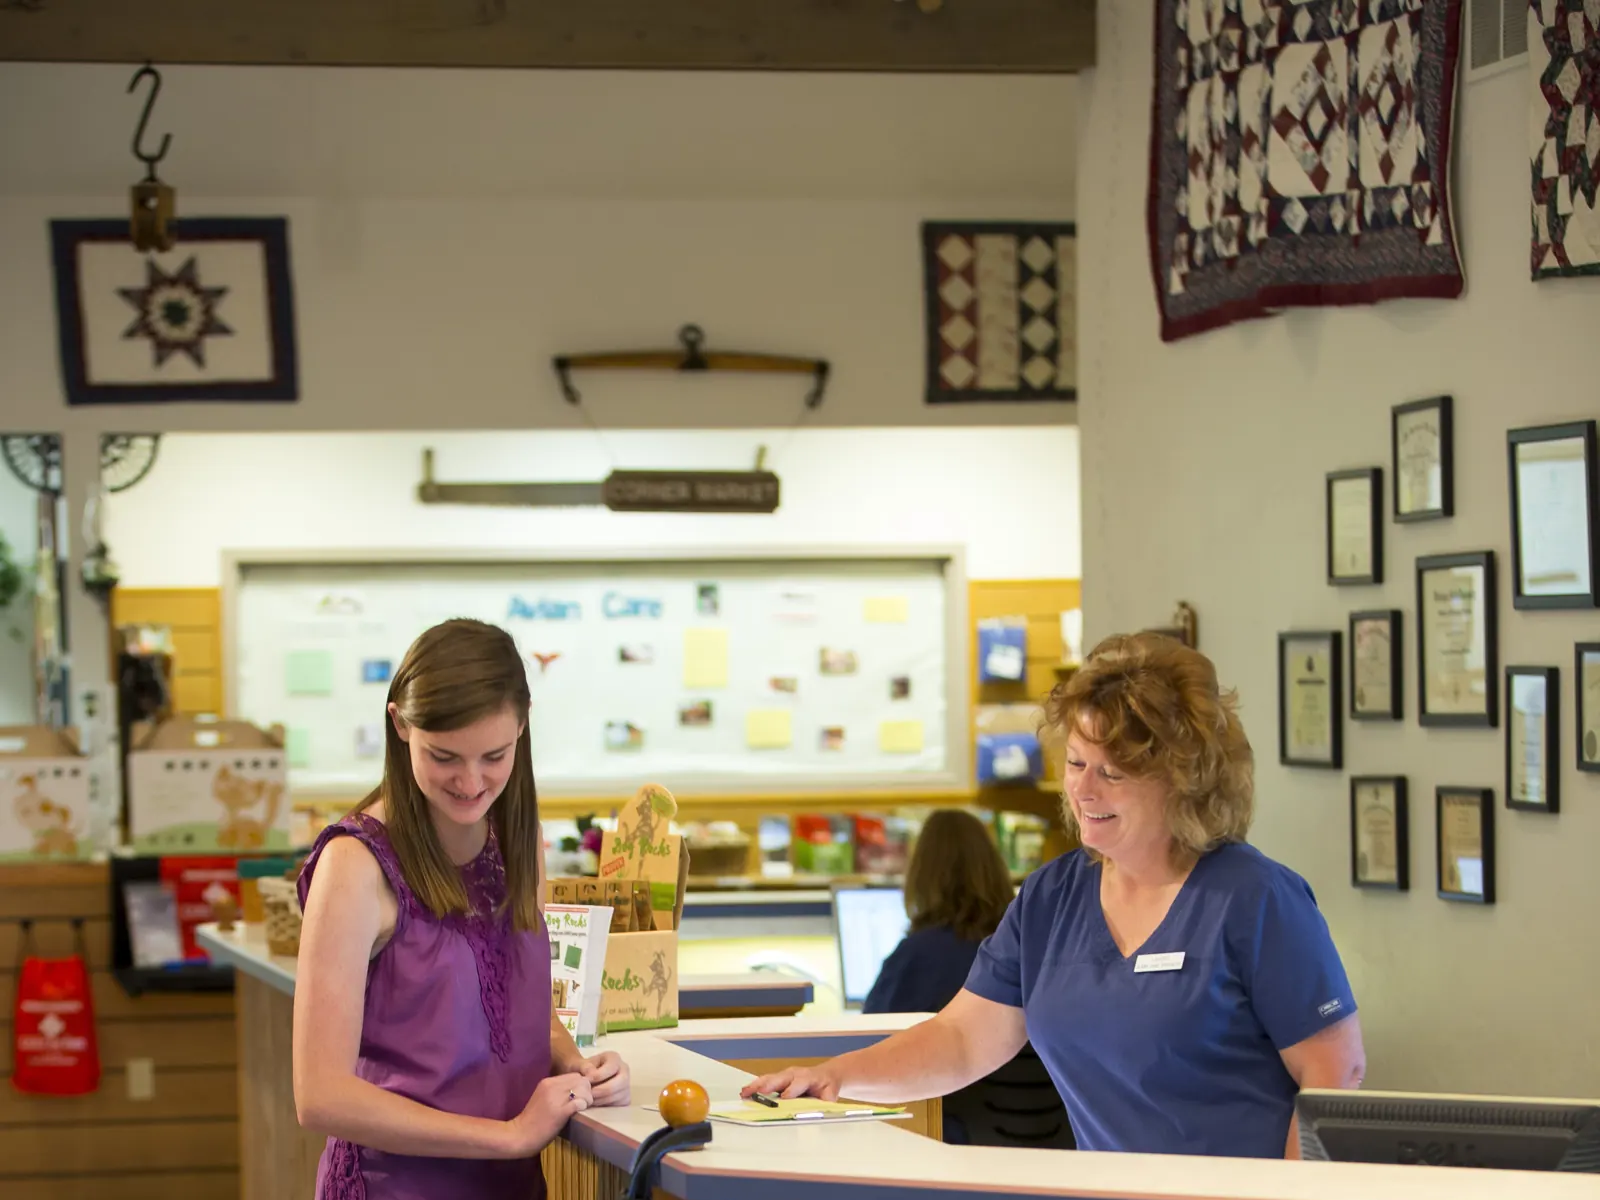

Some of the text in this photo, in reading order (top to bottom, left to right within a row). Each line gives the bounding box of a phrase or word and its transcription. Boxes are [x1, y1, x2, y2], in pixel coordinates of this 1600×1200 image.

[695, 481, 779, 503] MARKET
[506, 590, 663, 621] Avian Care
